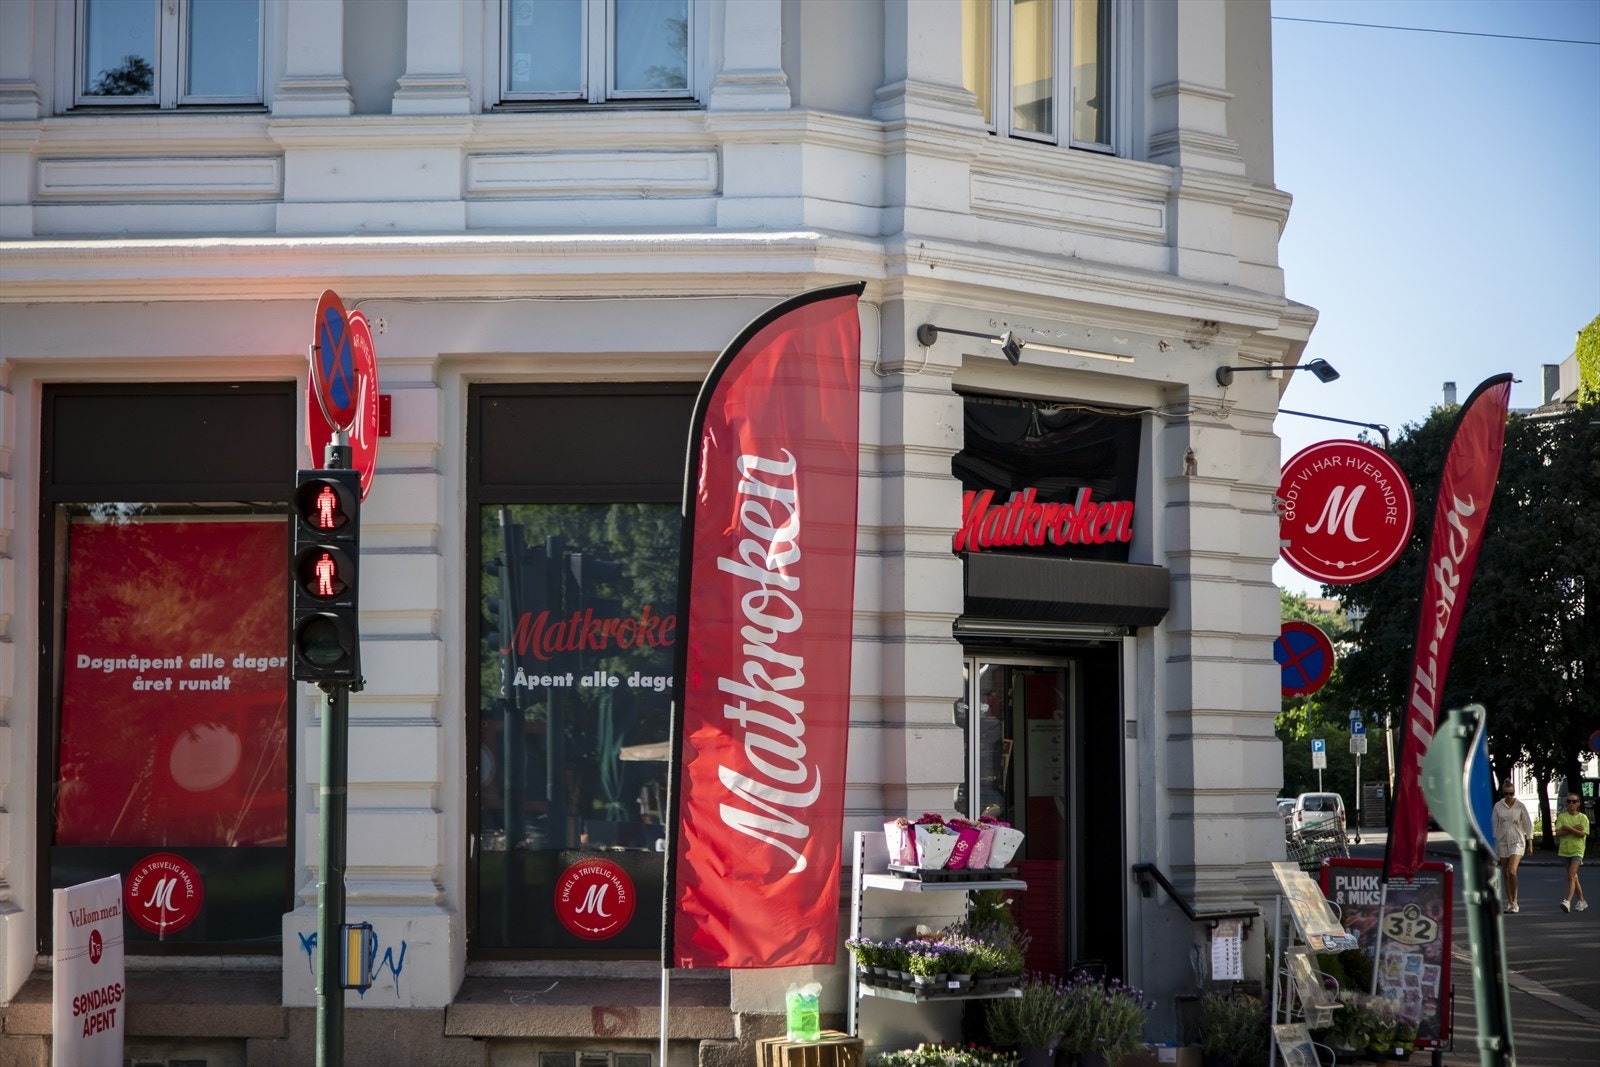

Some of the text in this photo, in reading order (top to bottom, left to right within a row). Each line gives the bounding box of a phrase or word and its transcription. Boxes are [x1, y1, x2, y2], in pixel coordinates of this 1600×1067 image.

[1285, 455, 1396, 525] GODT VI HAR HVERANDRE
[953, 487, 1134, 552] Matkroken
[1305, 484, 1370, 543] M
[500, 605, 677, 661] Matkroke
[77, 653, 288, 673] Døgnåpent alle dager
[717, 448, 821, 874] Matkroken
[132, 675, 231, 691] året rundt
[513, 667, 674, 692] Åpent alle dage
[131, 874, 144, 897] ENKEL
[148, 861, 180, 873] TRIVELIG
[179, 870, 194, 899] HANDEL
[143, 878, 180, 912] M
[562, 866, 626, 904] ENKEL & TRIVELIG HANDEL
[1335, 876, 1380, 890] PLUKK
[69, 898, 121, 929] Velkommen!
[575, 883, 612, 918] M
[1336, 890, 1381, 905] & MIKS
[1388, 917, 1404, 936] 3
[1415, 920, 1432, 940] 2
[72, 983, 125, 1017] SØNDAGS-
[82, 1008, 117, 1039] ÅPENT
